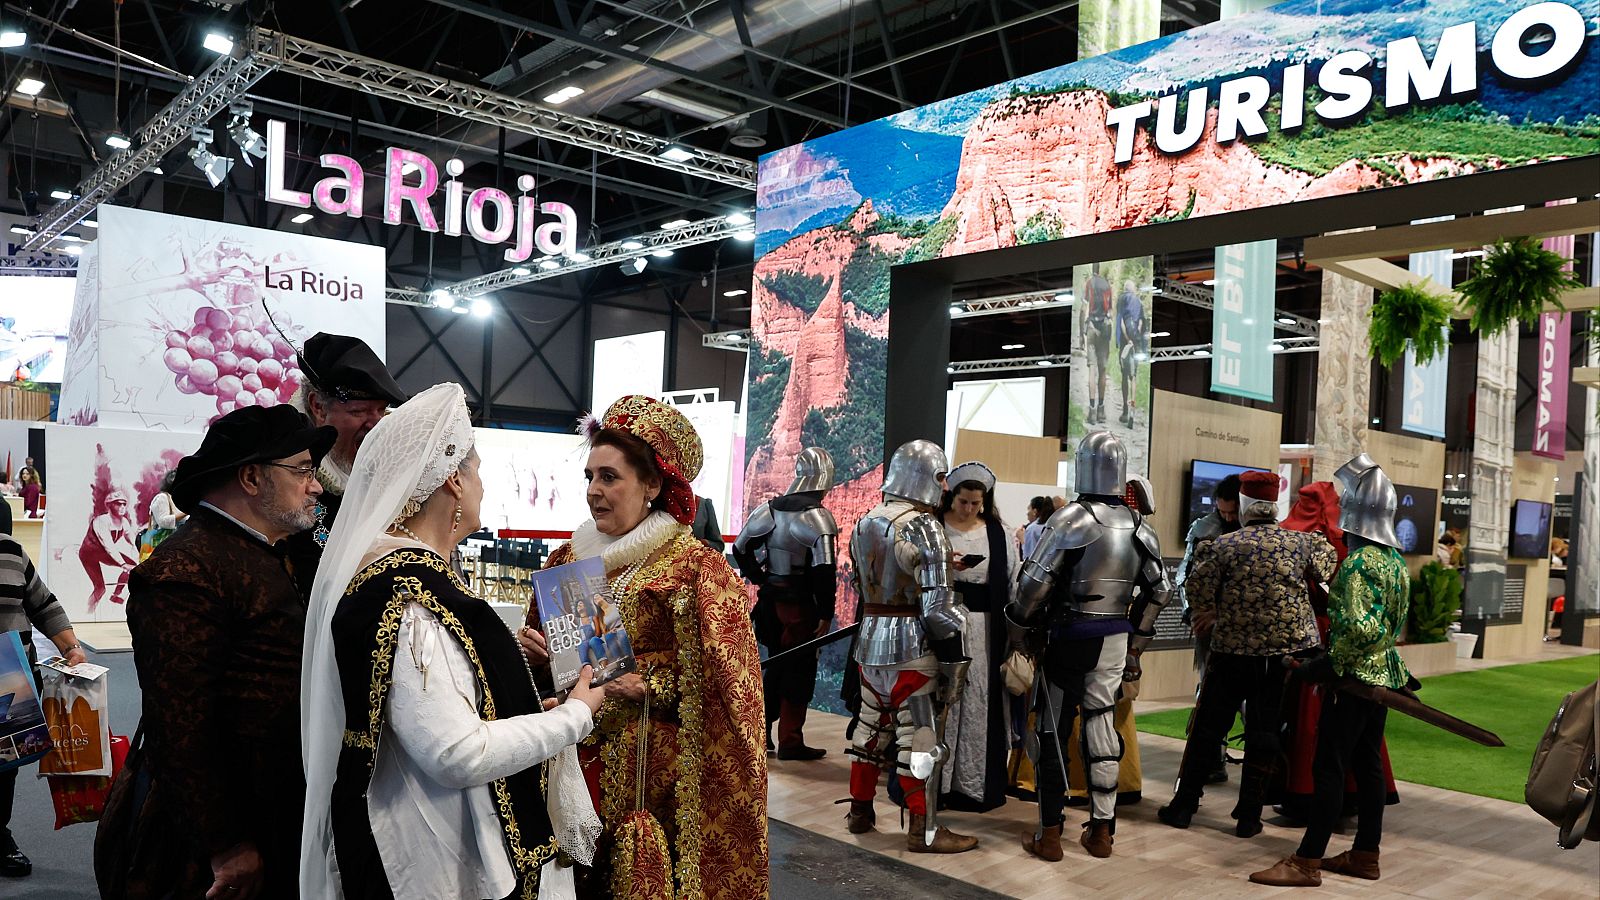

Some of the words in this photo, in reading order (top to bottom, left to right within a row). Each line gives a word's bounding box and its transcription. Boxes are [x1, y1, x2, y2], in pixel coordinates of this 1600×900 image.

[1106, 1, 1587, 164] TURISMO
[265, 118, 365, 218] La
[383, 146, 578, 263] Rioja
[265, 265, 293, 291] La
[301, 270, 364, 302] Rioja
[1196, 427, 1217, 439] Camino
[1219, 432, 1226, 441] de
[546, 613, 578, 637] BUR
[550, 630, 582, 654] GOS
